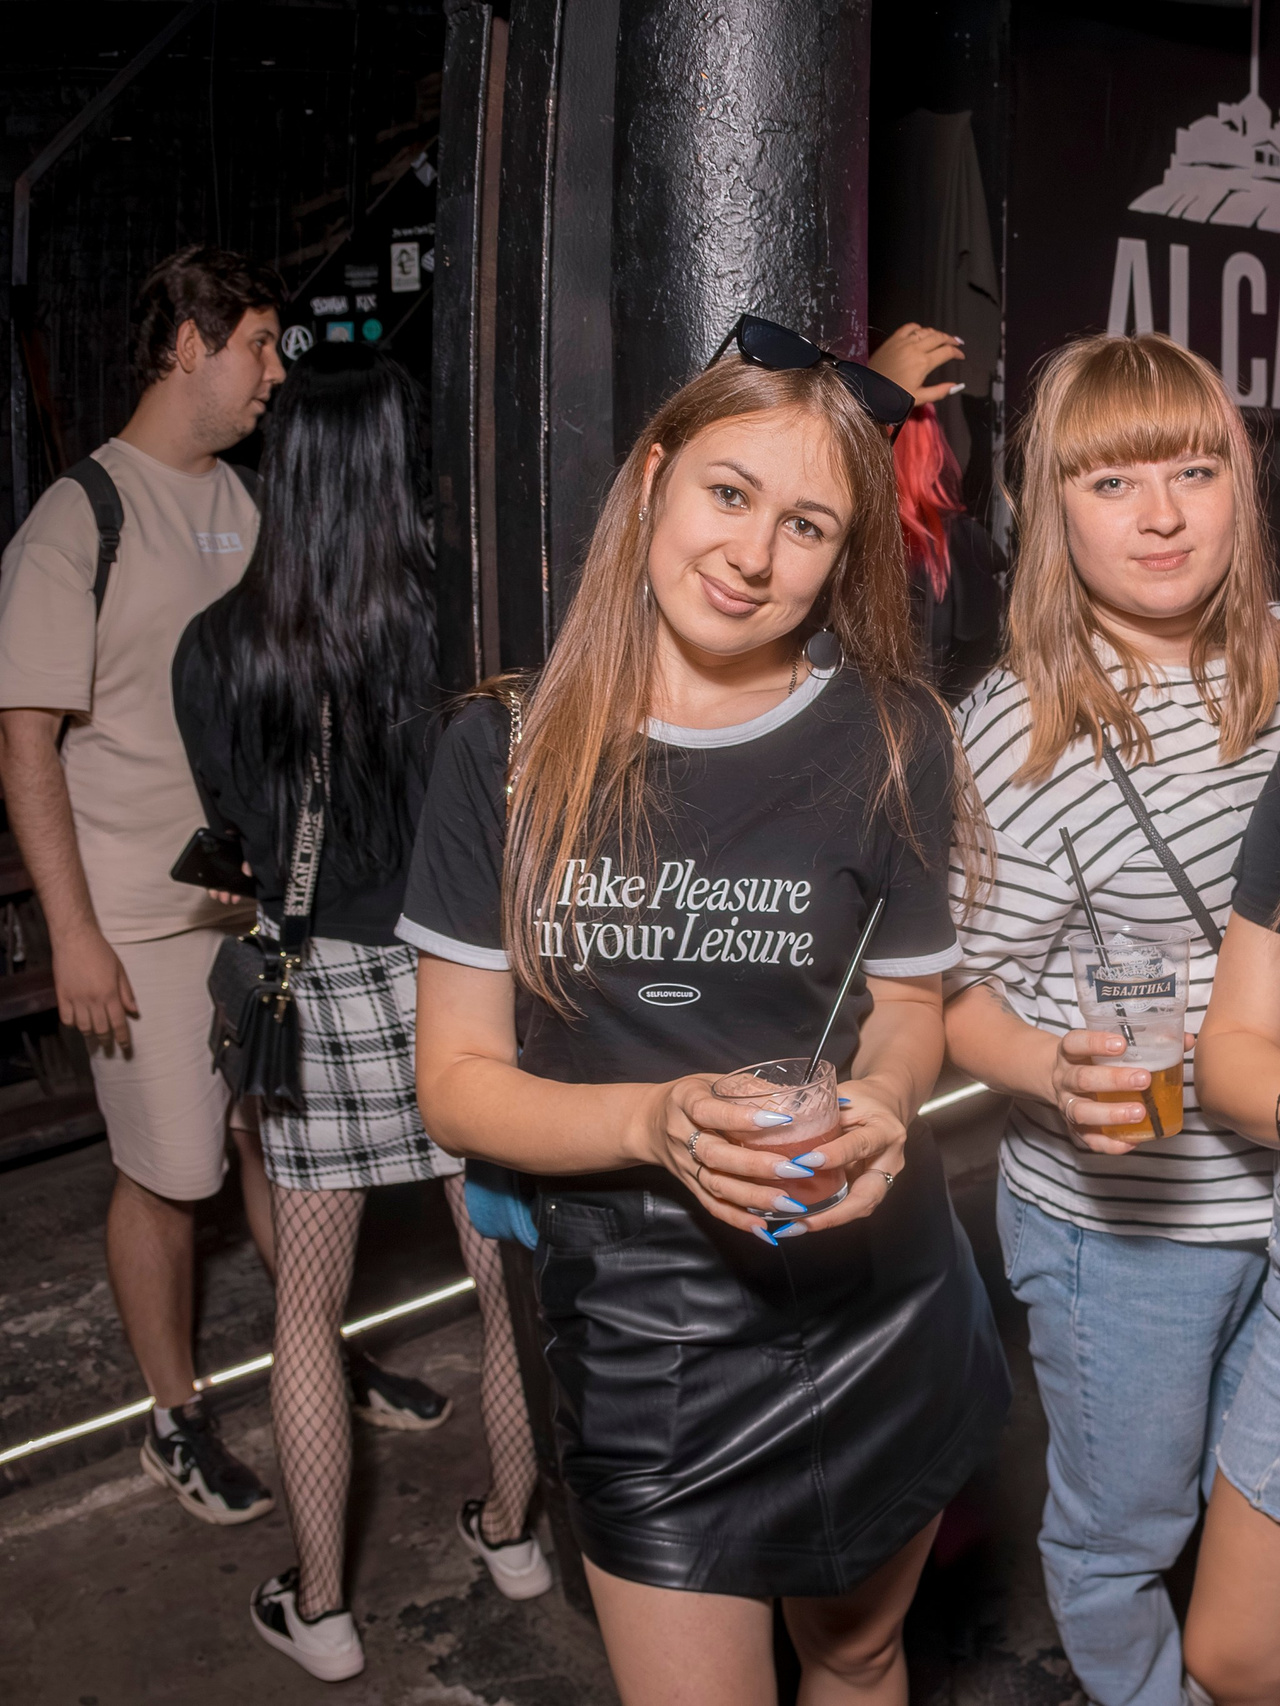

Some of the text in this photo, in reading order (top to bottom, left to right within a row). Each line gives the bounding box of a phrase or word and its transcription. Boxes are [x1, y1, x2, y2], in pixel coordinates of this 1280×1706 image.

[556, 856, 812, 914] Take Pleasure
[533, 908, 815, 972] in your Leisure.
[1112, 981, 1171, 997] БАЛТИКА
